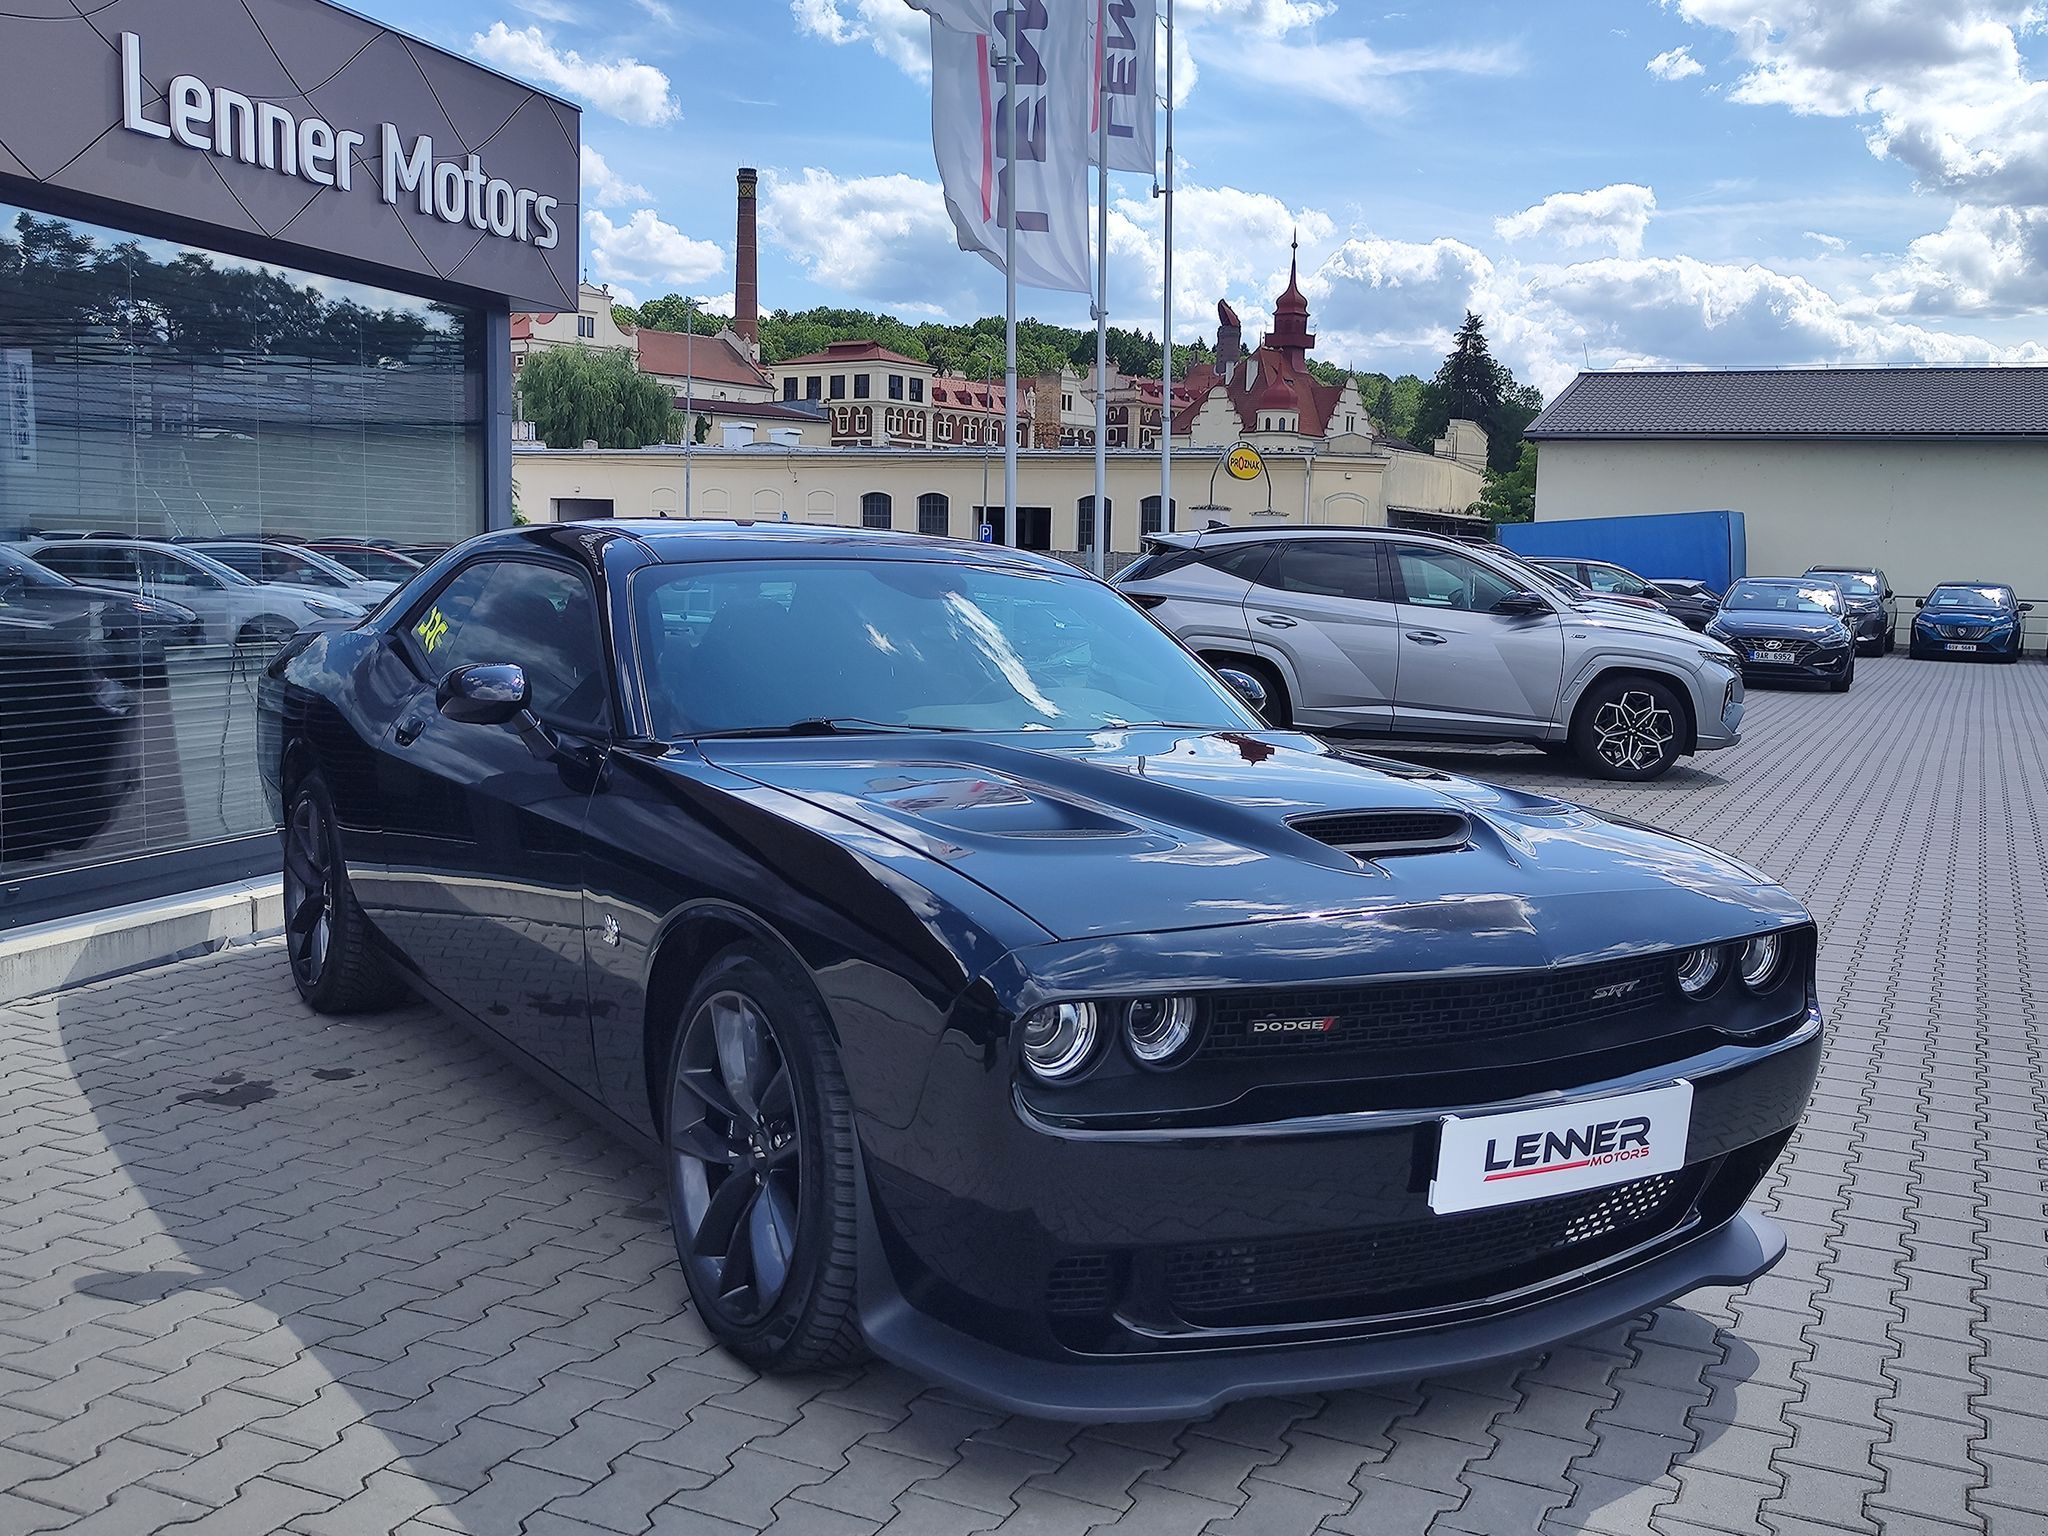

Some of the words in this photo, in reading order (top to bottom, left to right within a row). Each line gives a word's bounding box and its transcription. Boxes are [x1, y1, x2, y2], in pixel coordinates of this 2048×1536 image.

[121, 31, 364, 192] Lenner
[380, 122, 559, 249] Motors
[1230, 456, 1260, 470] PROZNAK
[982, 527, 990, 540] P
[1755, 651, 1769, 659] 9AR
[1773, 652, 1792, 660] 6952
[1591, 979, 1641, 999] SRT
[1253, 1020, 1325, 1032] DODGE
[1484, 1116, 1651, 1172] LENNER
[1589, 1146, 1650, 1167] MOTORS
